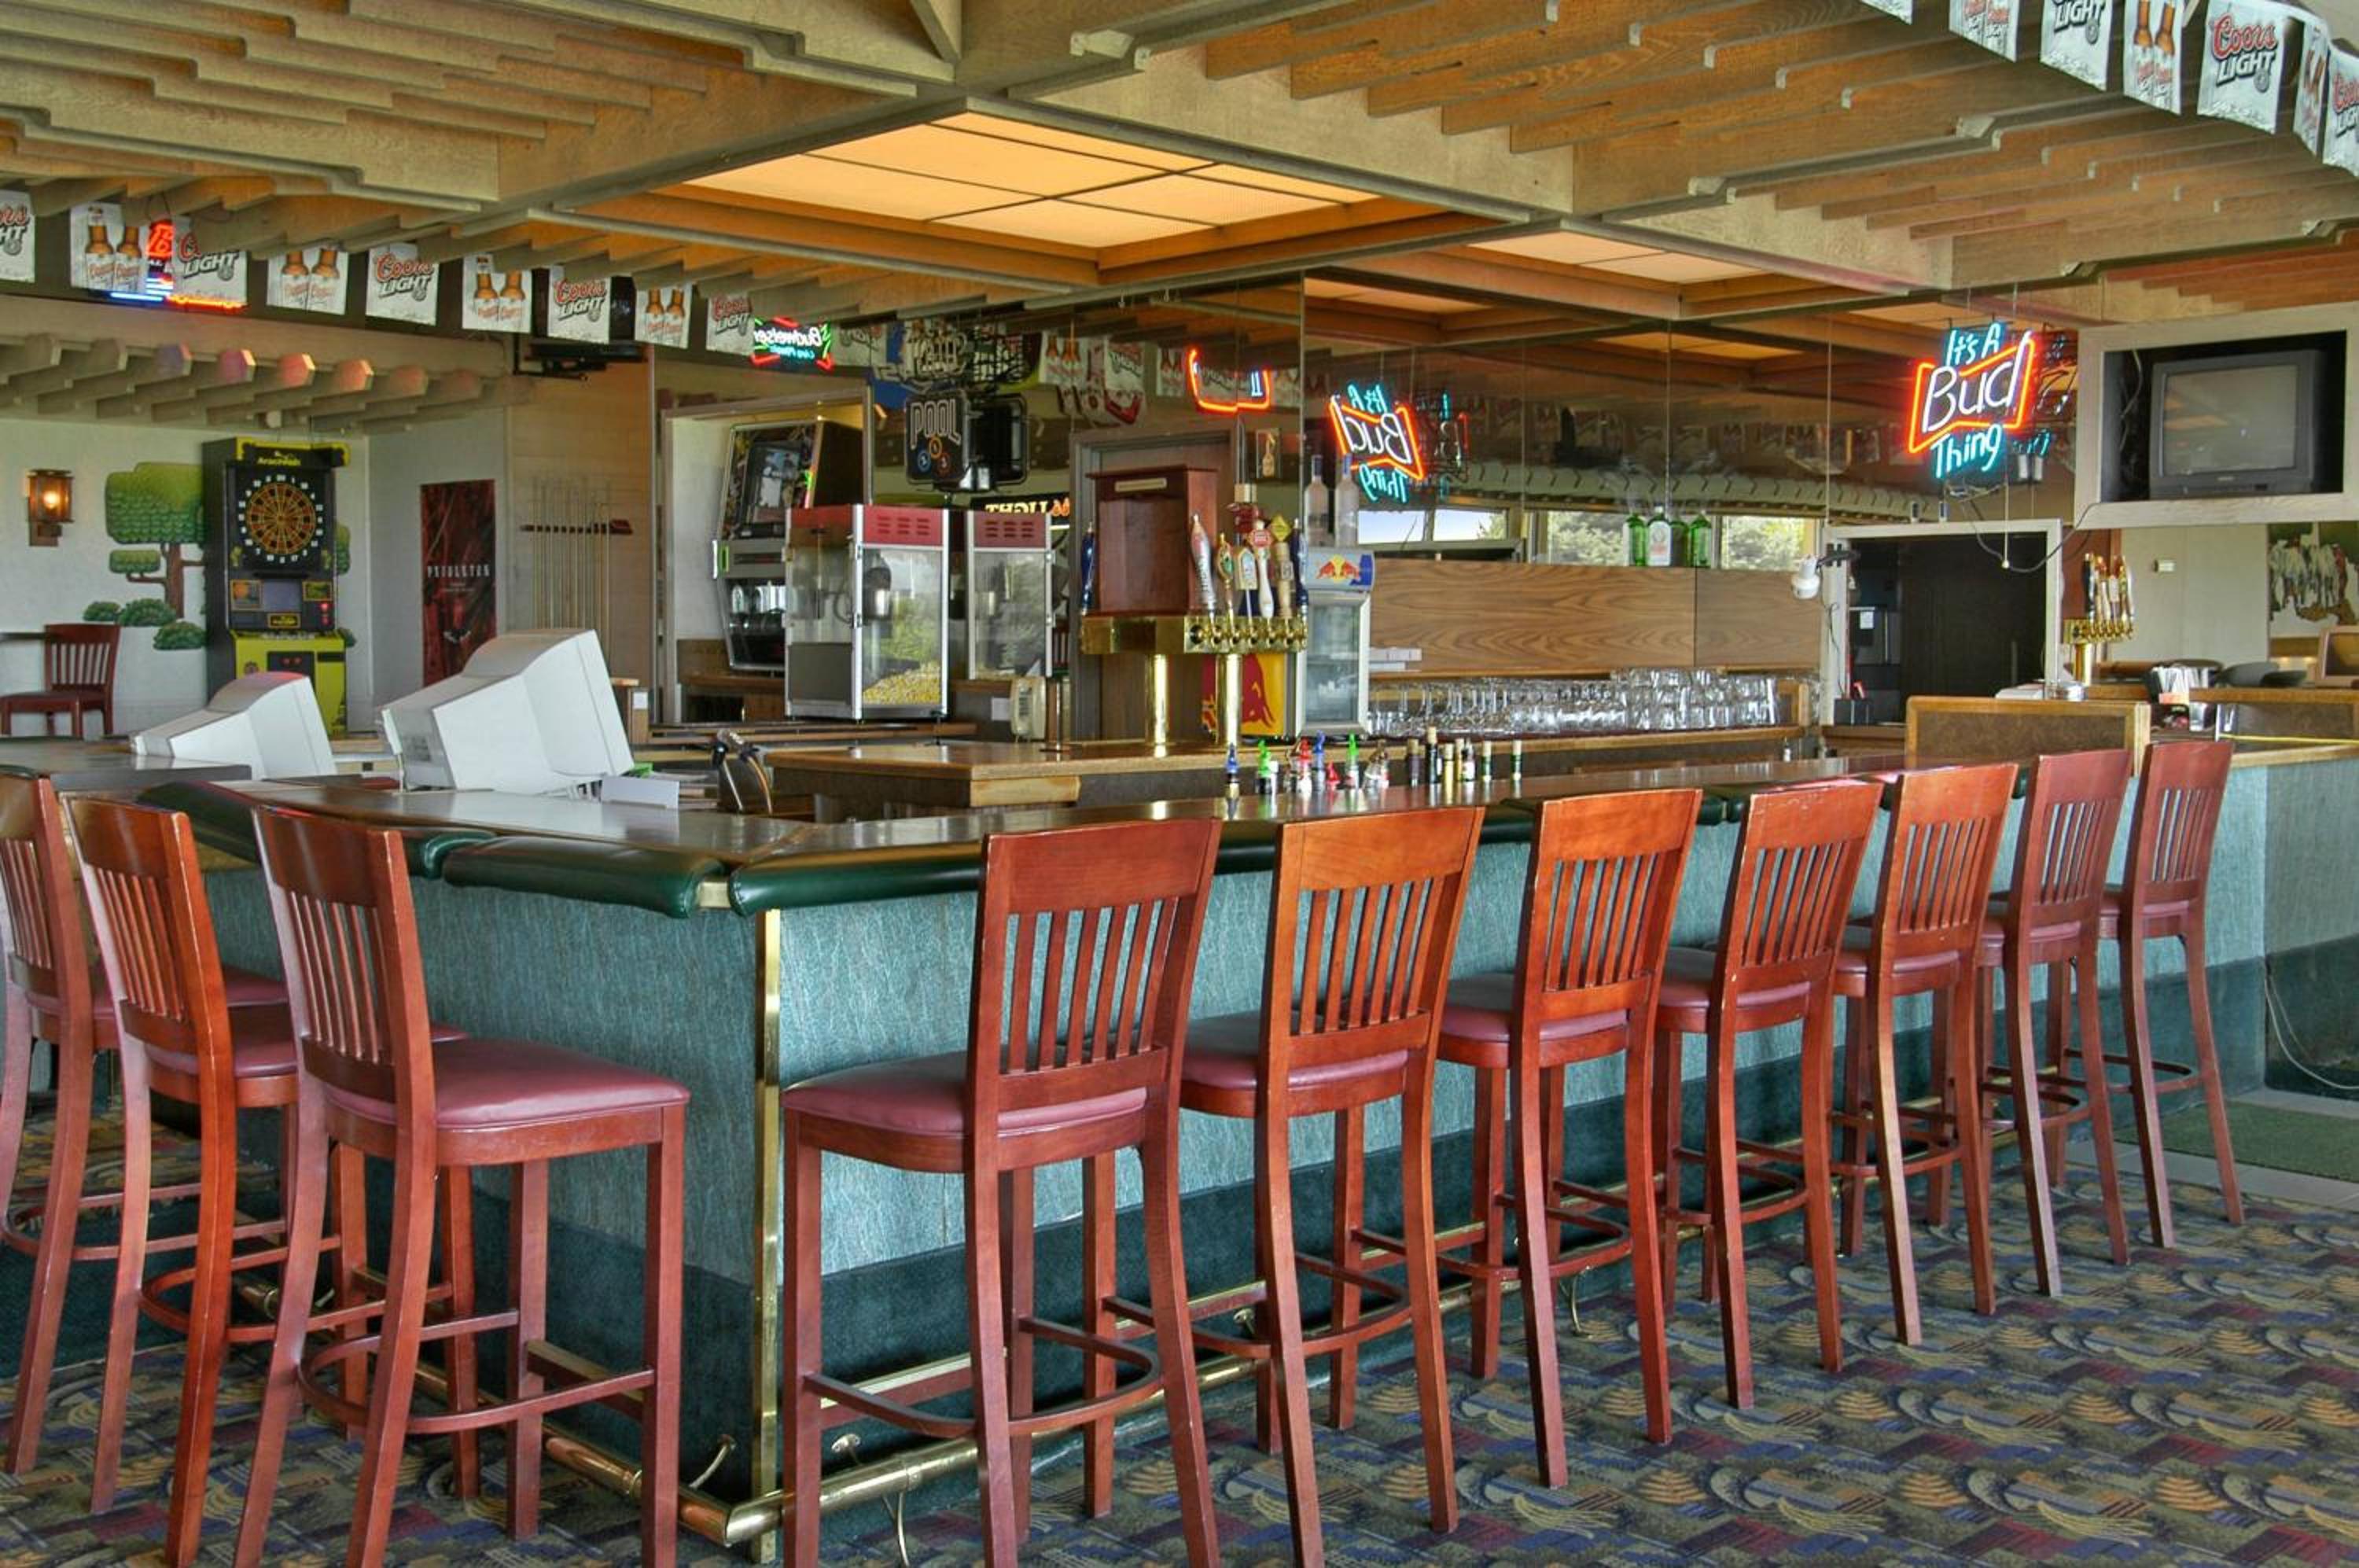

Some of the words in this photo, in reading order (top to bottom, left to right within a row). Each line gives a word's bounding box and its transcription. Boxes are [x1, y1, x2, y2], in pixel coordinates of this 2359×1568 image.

[2054, 0, 2107, 33] LIGHT
[2213, 13, 2278, 60] Coors
[2216, 52, 2276, 86] LIGHT
[183, 252, 239, 279] LIGHT
[376, 252, 435, 284] Coors
[378, 275, 432, 299] LIGHT
[554, 278, 607, 307] Coors
[558, 296, 605, 322] LIGHT
[1946, 329, 1978, 366] It's
[1981, 322, 2002, 359] A
[1922, 330, 2033, 433] Bud
[910, 399, 961, 450] POOL
[1930, 424, 2002, 479] Thing
